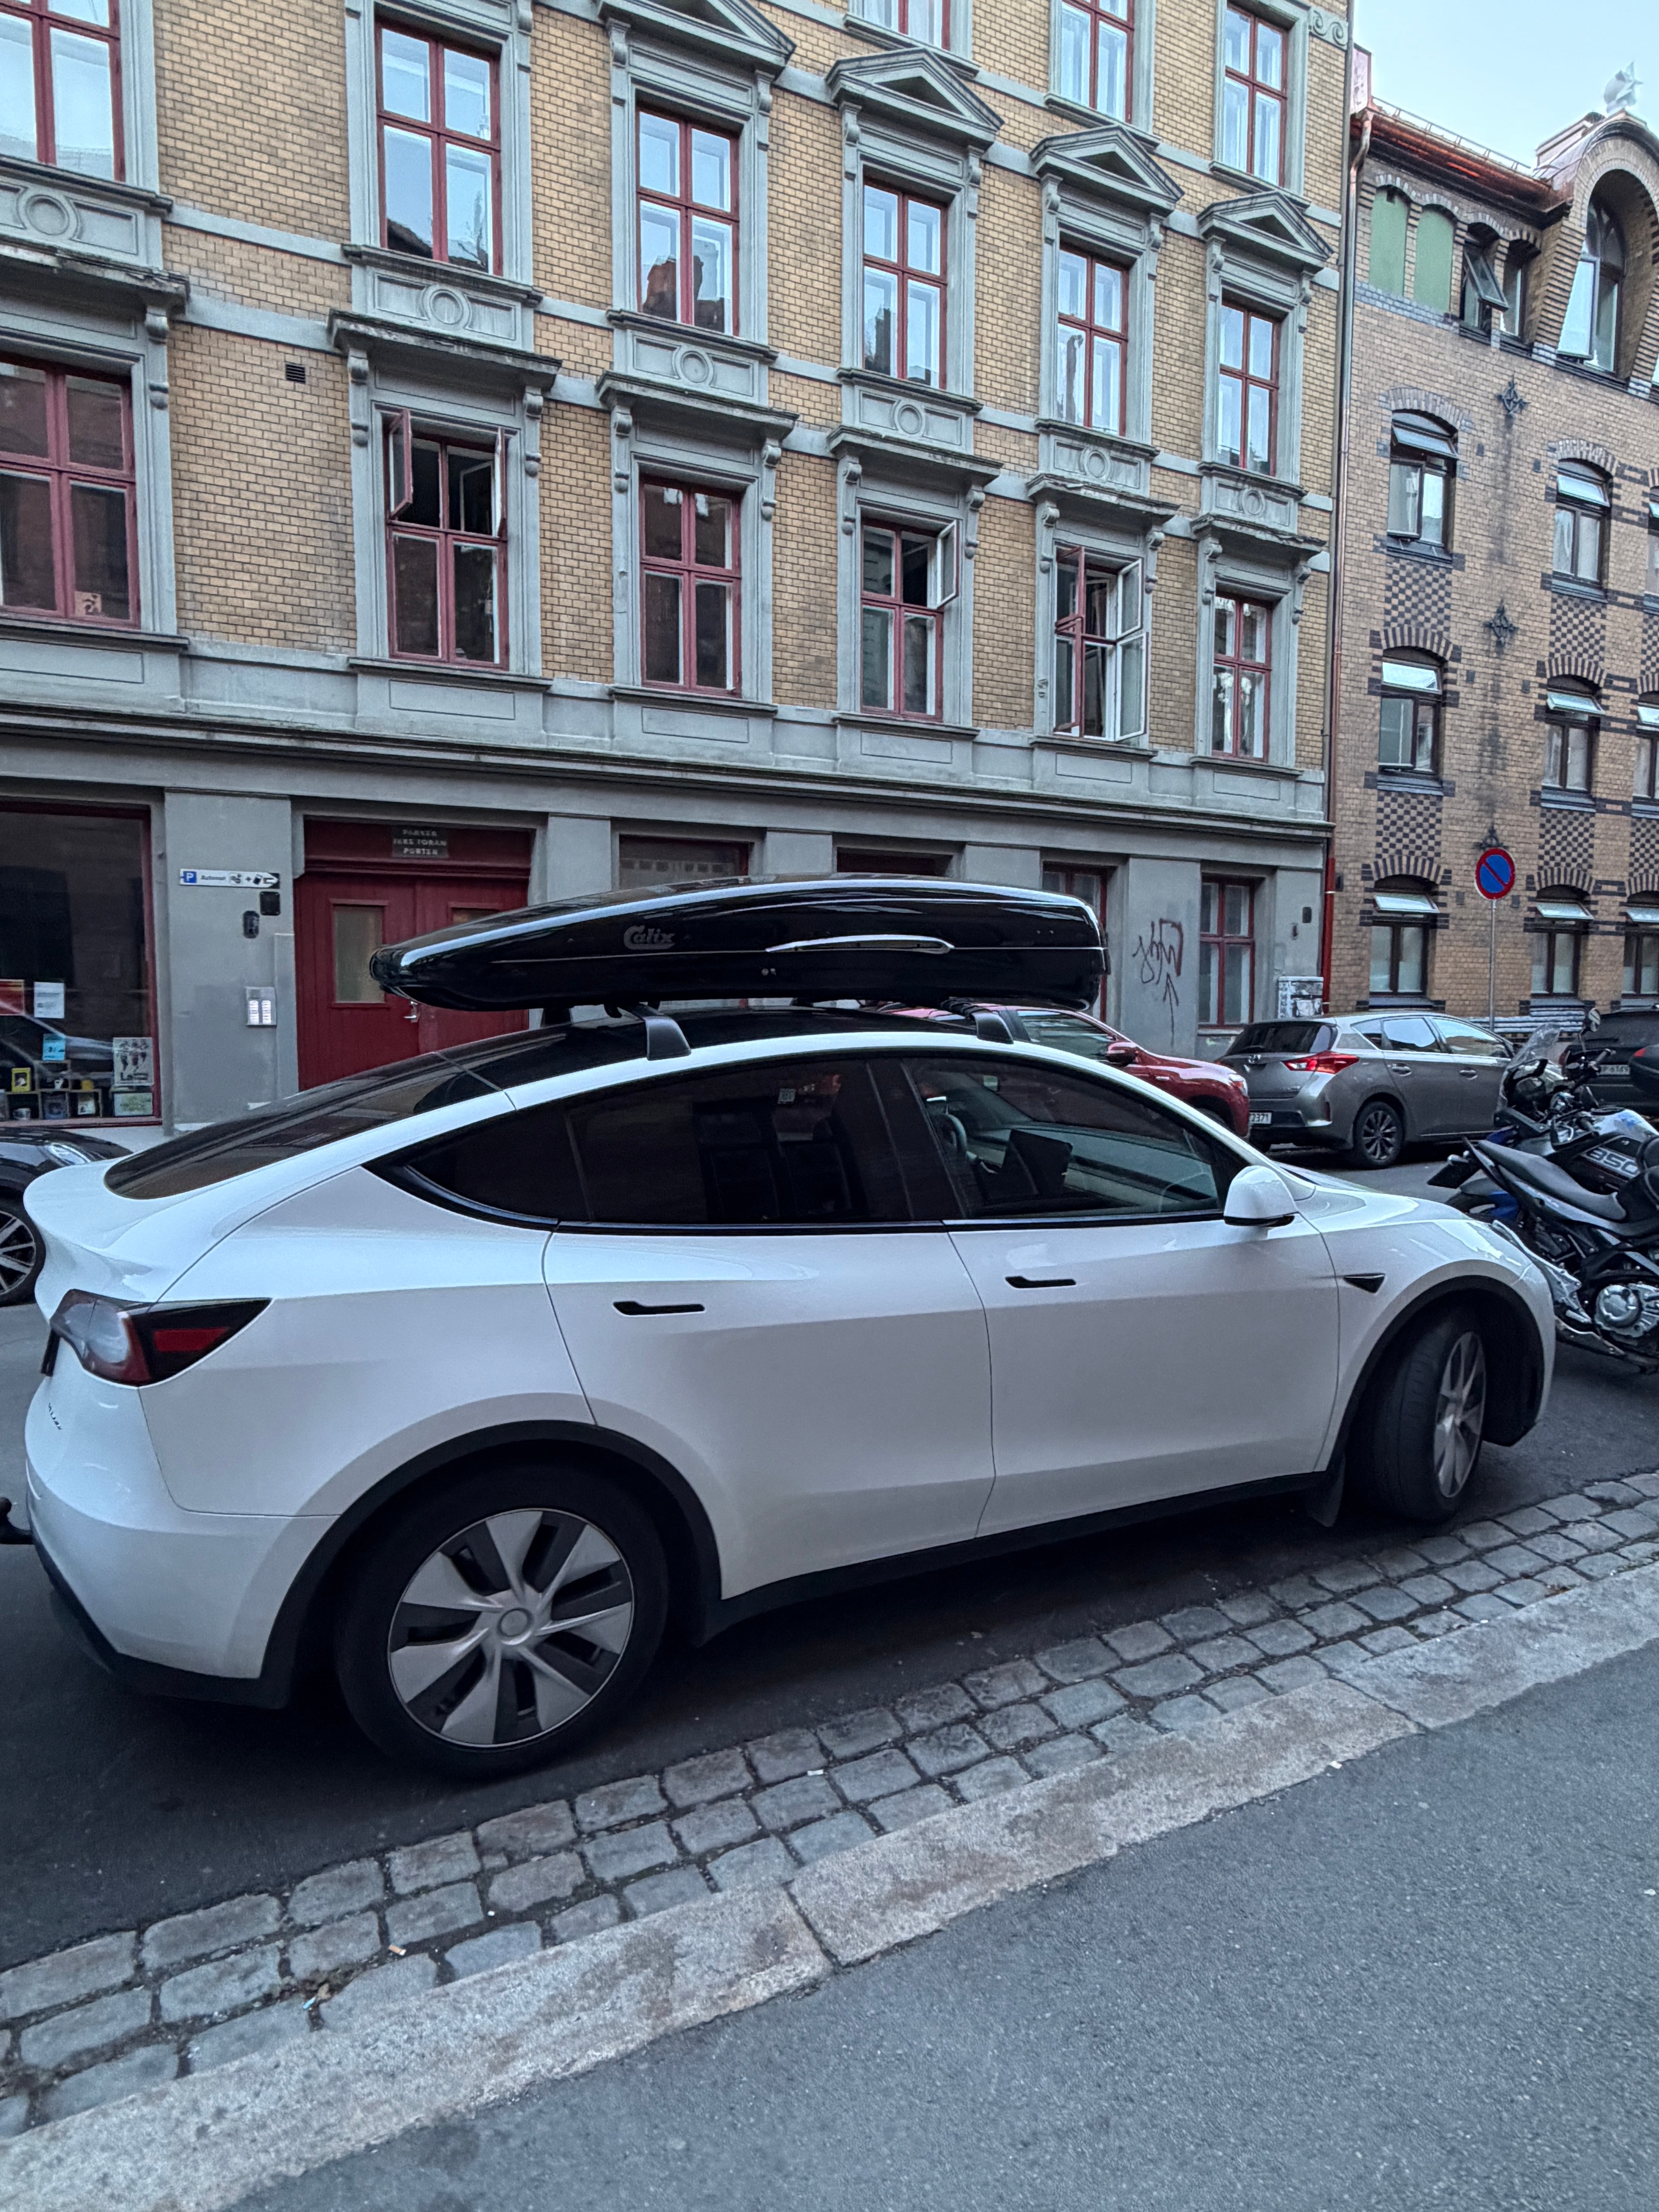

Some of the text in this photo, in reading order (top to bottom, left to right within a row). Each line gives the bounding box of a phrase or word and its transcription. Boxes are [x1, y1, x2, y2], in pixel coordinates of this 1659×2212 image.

[186, 872, 194, 882] P
[623, 925, 676, 950] Calix
[1587, 1147, 1639, 1175] 350
